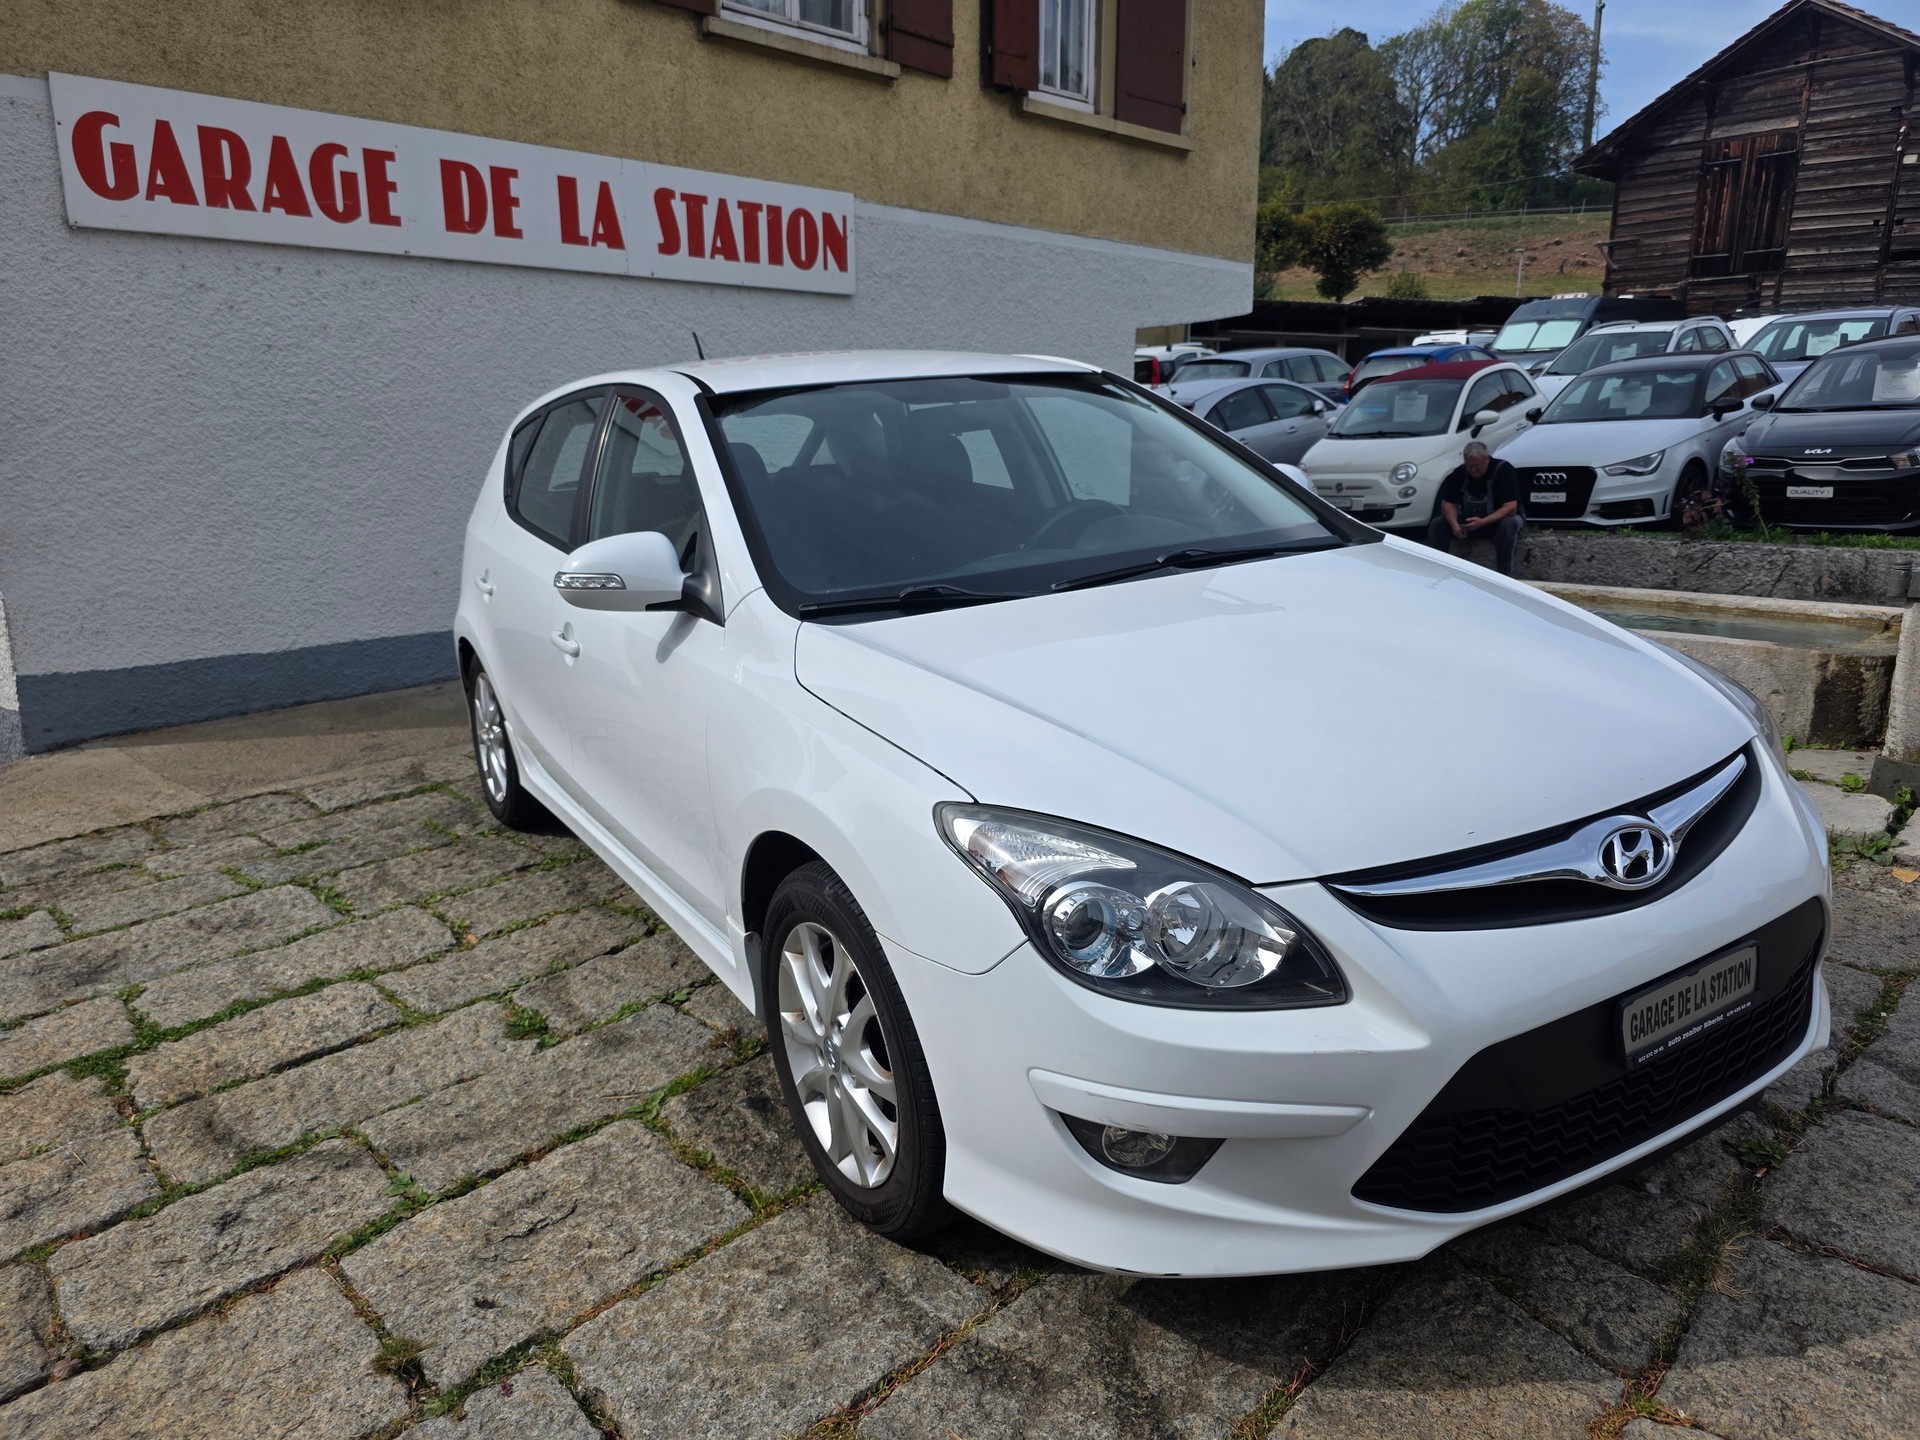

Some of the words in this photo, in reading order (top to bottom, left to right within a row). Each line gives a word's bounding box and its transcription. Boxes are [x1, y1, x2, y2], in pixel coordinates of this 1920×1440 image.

[72, 111, 402, 227] GARAGE
[440, 159, 523, 239] DE
[557, 175, 625, 251] LA
[654, 187, 848, 273] STATION
[1630, 993, 1675, 1042] GARAGE
[1678, 987, 1692, 1020] DE
[1694, 980, 1707, 1013] LA
[1709, 958, 1751, 1003] STATION
[1668, 1036, 1681, 1047] auto
